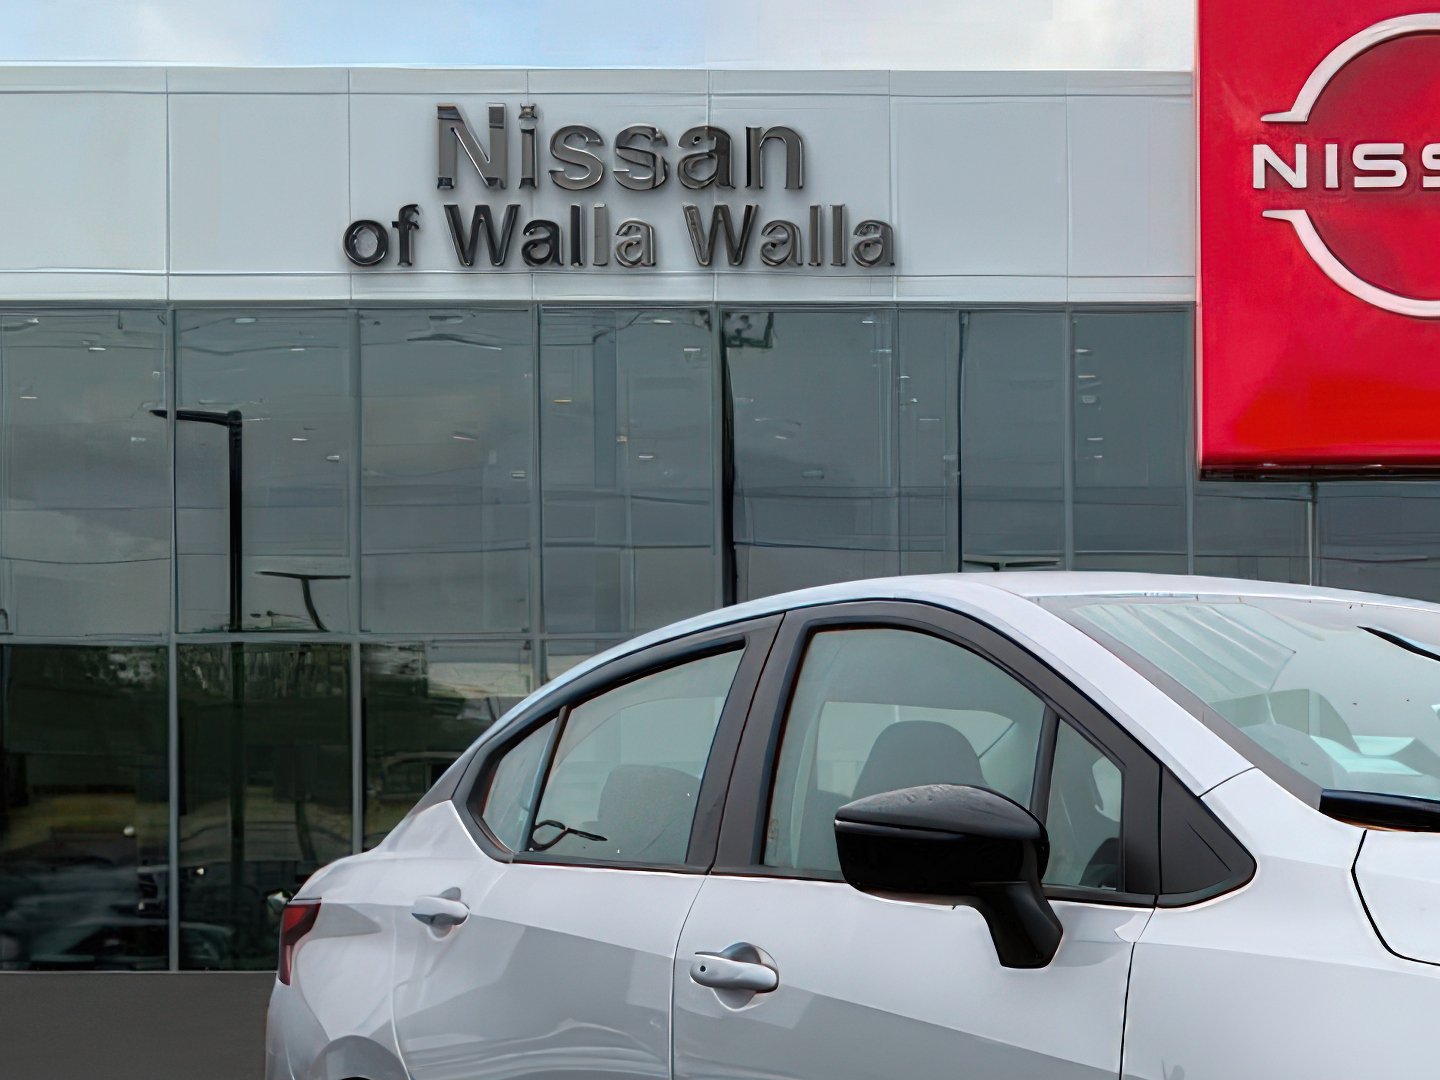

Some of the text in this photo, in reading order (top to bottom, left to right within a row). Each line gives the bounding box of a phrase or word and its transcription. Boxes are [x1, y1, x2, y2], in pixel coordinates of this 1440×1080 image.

[436, 103, 803, 190] Nissan
[342, 203, 897, 267] of Walla Walla
